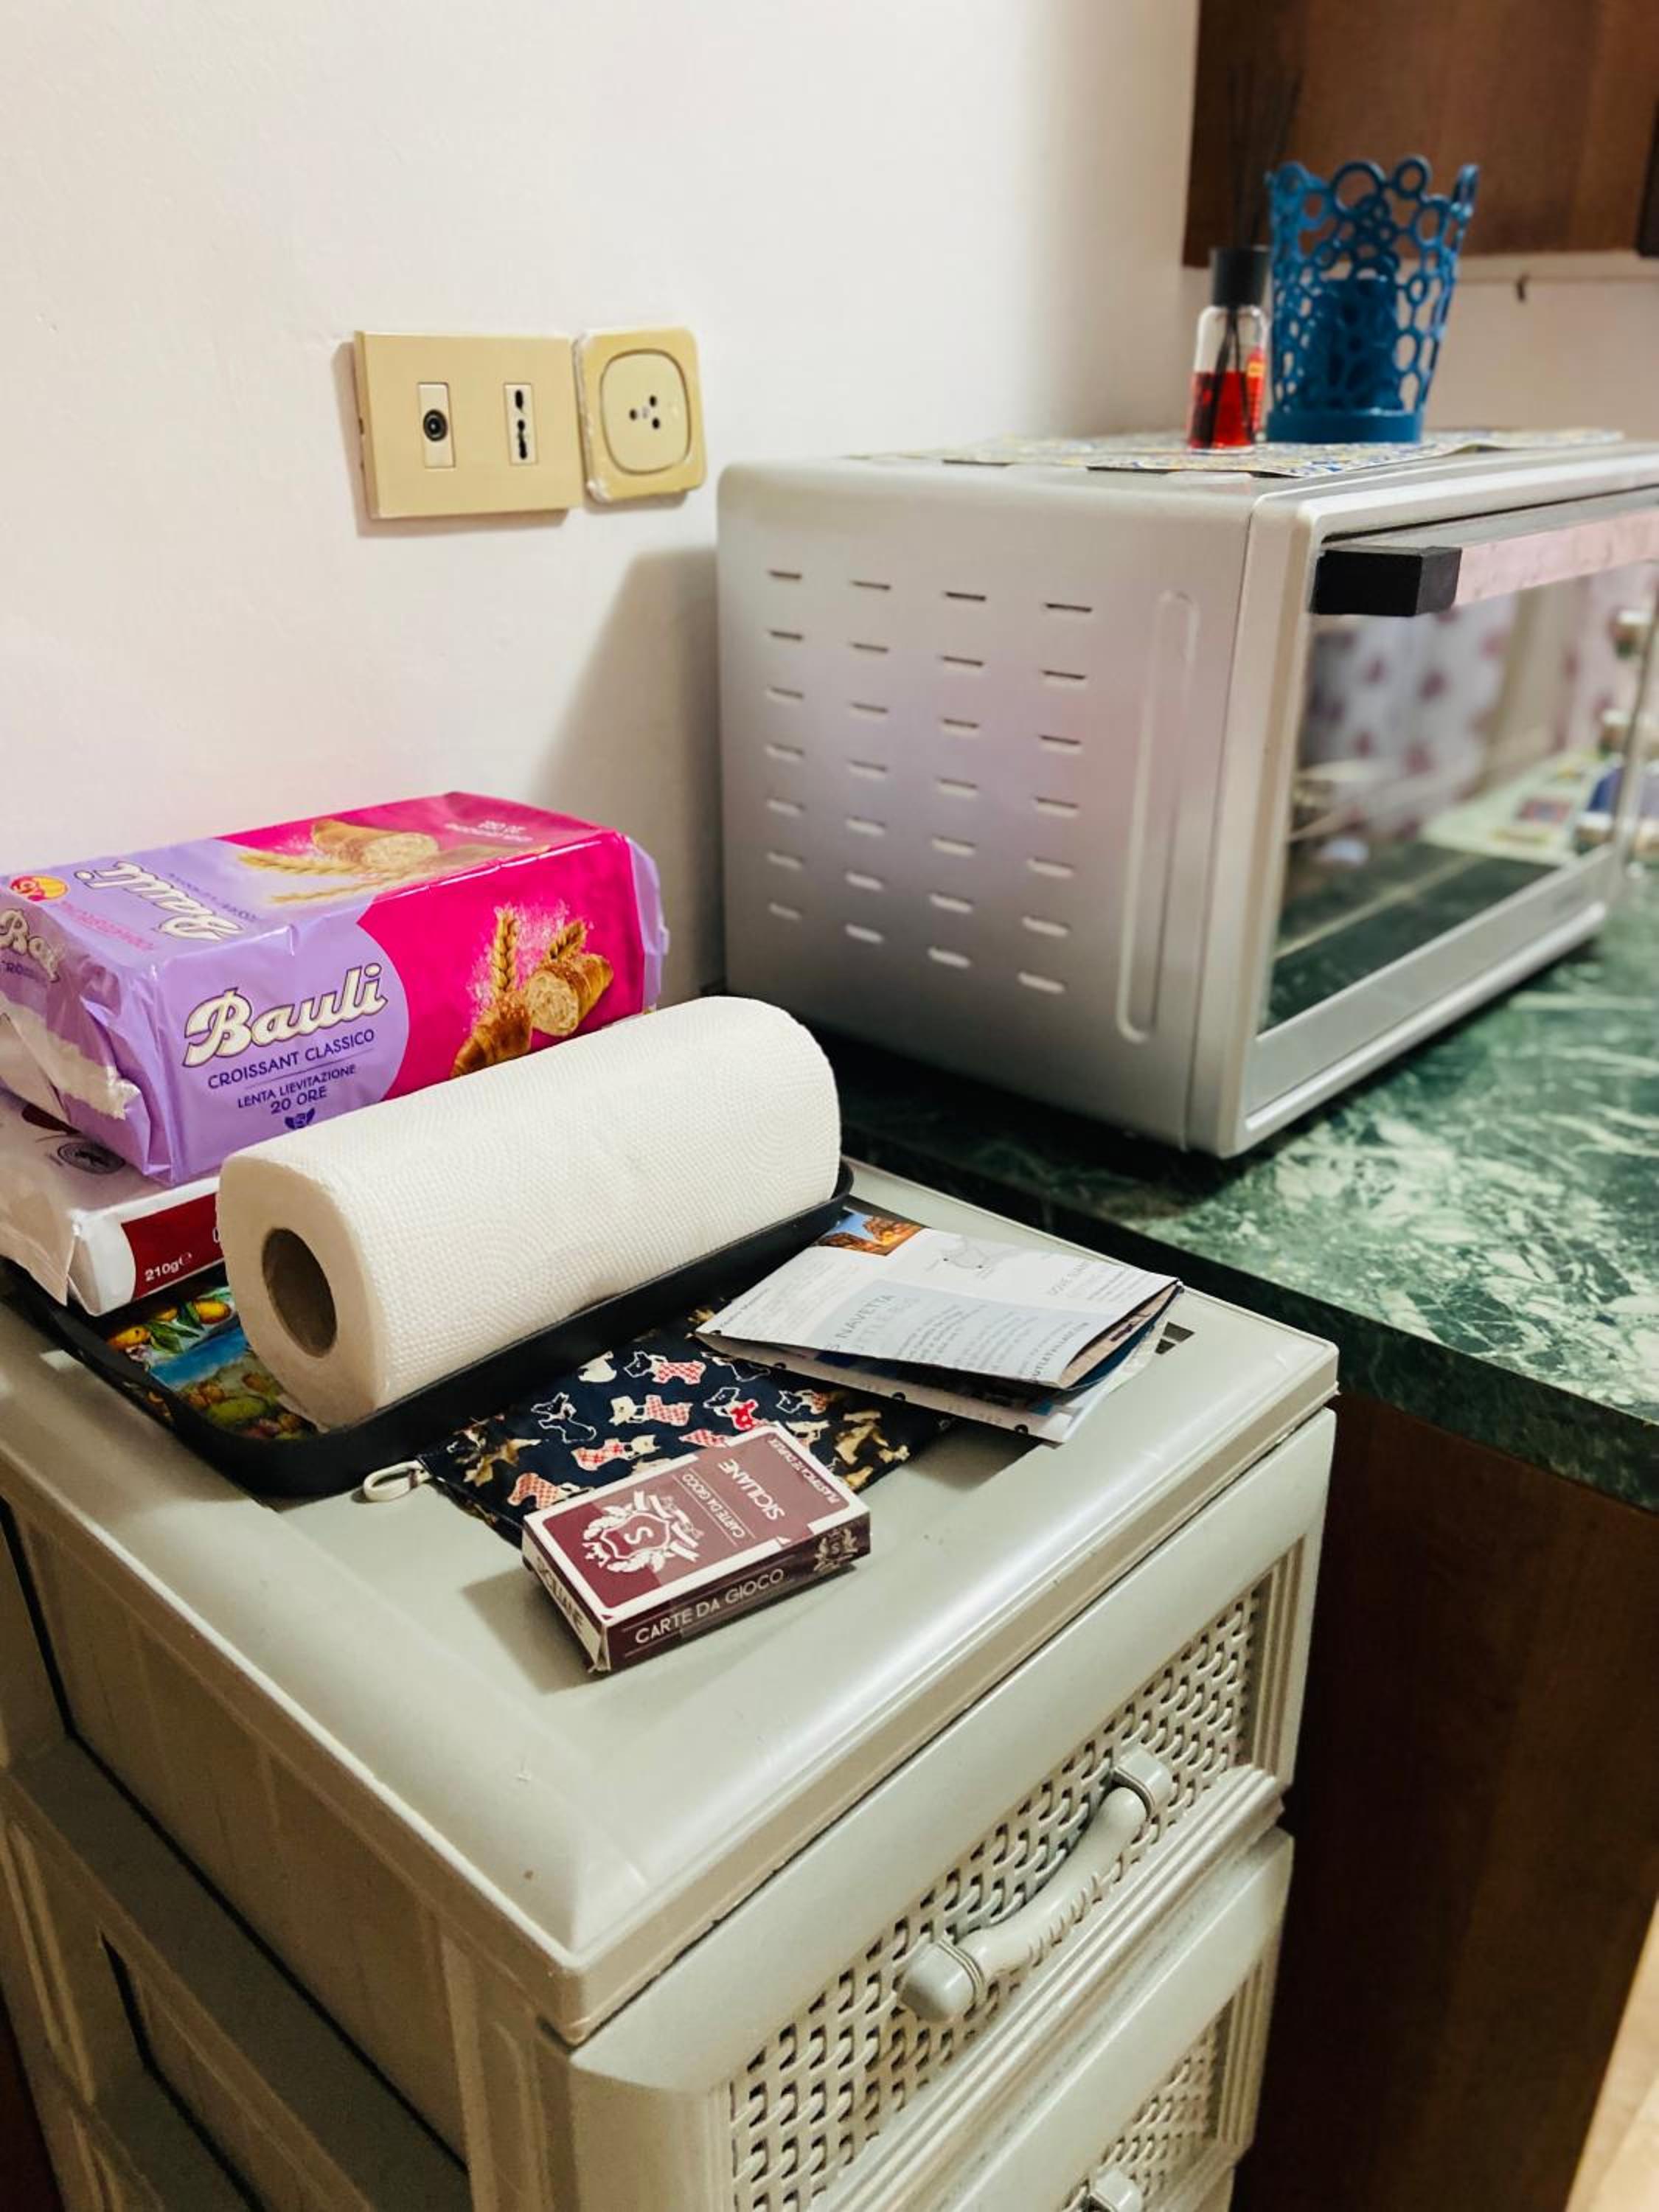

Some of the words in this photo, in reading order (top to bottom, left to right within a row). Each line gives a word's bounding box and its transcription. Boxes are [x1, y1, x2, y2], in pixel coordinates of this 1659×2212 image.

[74, 860, 246, 942] Bauli
[182, 961, 388, 1068] Bauli
[207, 1053, 299, 1090] CROISSANT
[305, 1029, 375, 1062] CLASSICO
[237, 1089, 276, 1109] LENTA
[279, 1064, 356, 1096] LIEVITAZIONE
[271, 1098, 291, 1114] 20
[297, 1085, 327, 1105] ORE
[680, 1473, 712, 1500] GIOCO
[703, 1497, 725, 1513] DA
[718, 1458, 785, 1520] SICILIANE
[715, 1509, 745, 1539] CARTE
[635, 1608, 692, 1645] CARTE
[695, 1598, 722, 1621] DA
[725, 1568, 785, 1606] GIOCO
